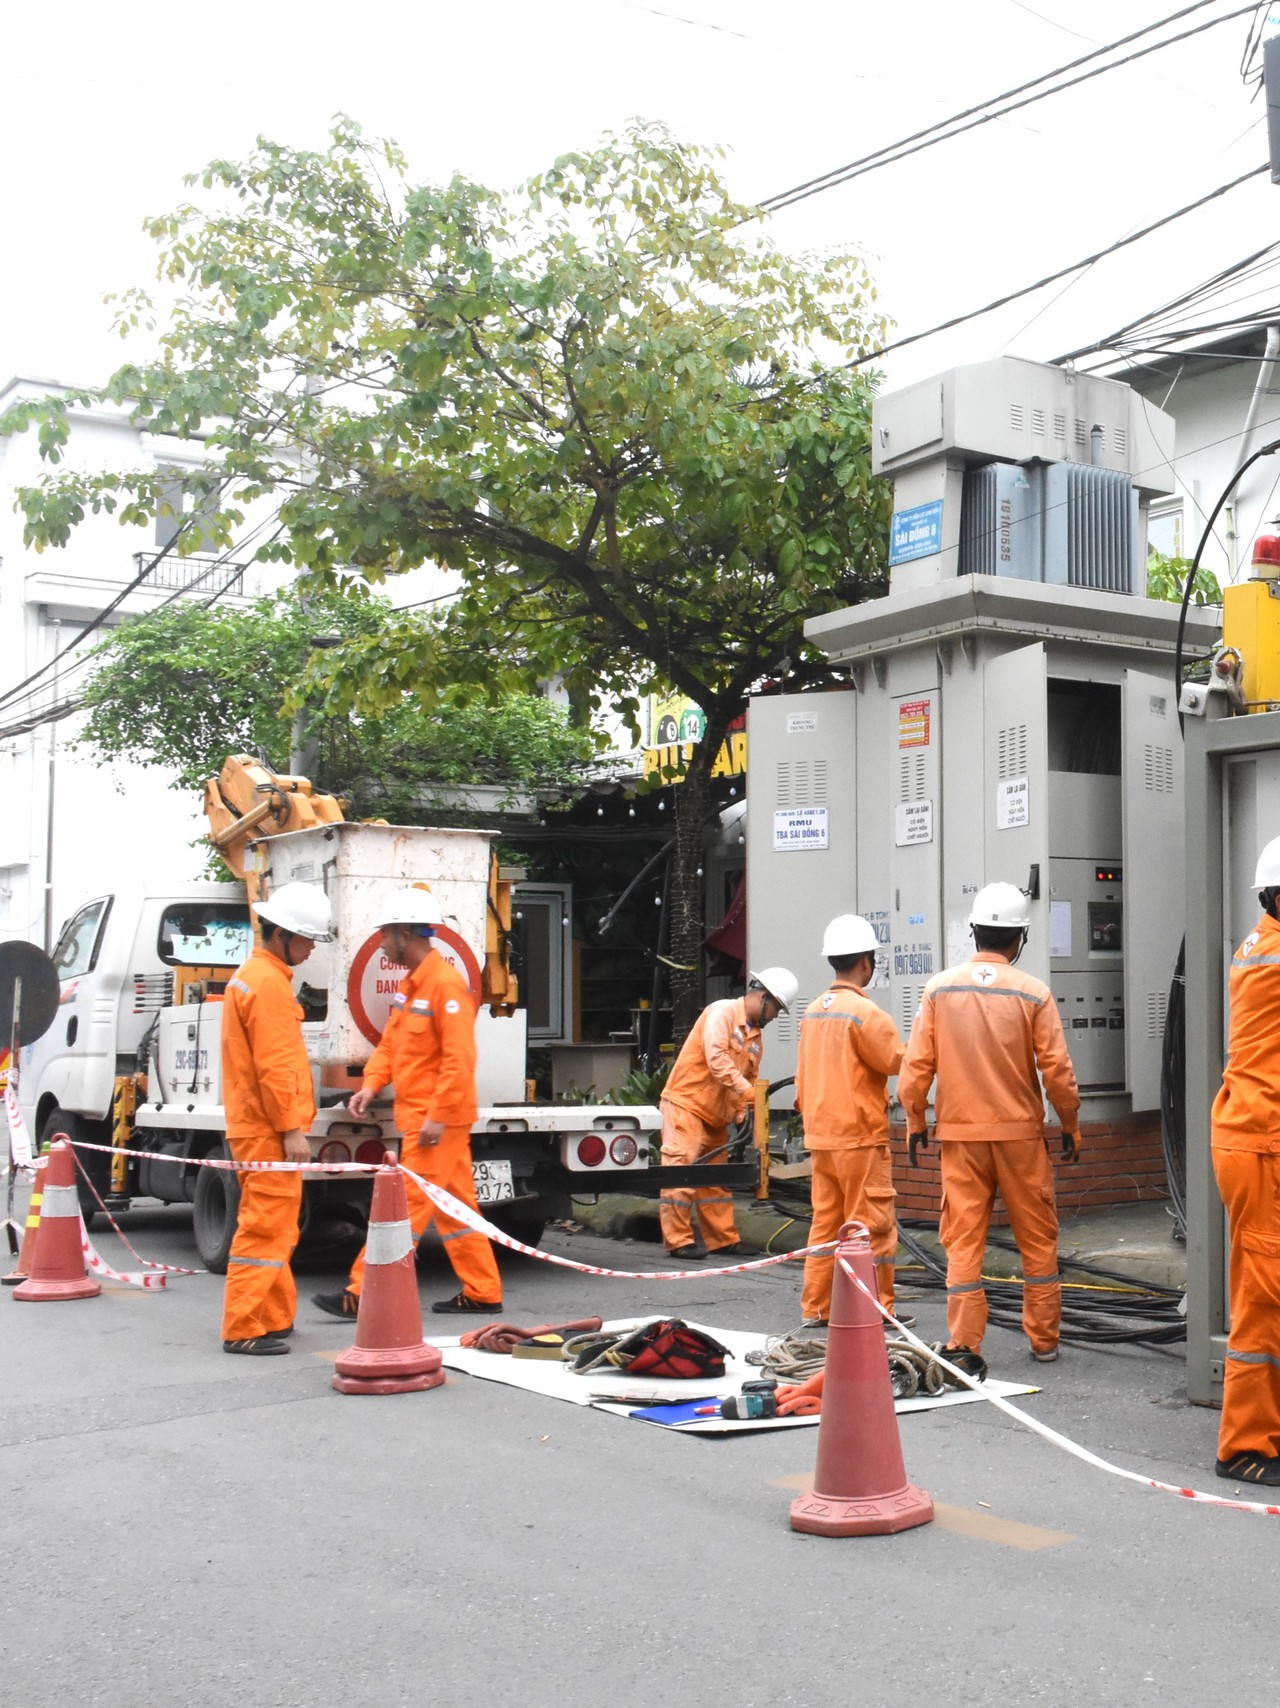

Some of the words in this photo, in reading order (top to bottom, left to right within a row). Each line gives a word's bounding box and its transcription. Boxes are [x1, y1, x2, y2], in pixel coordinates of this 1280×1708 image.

[669, 724, 676, 737] 8
[687, 720, 698, 736] 14
[776, 831, 788, 839] TBA
[376, 979, 399, 994] ĐAN
